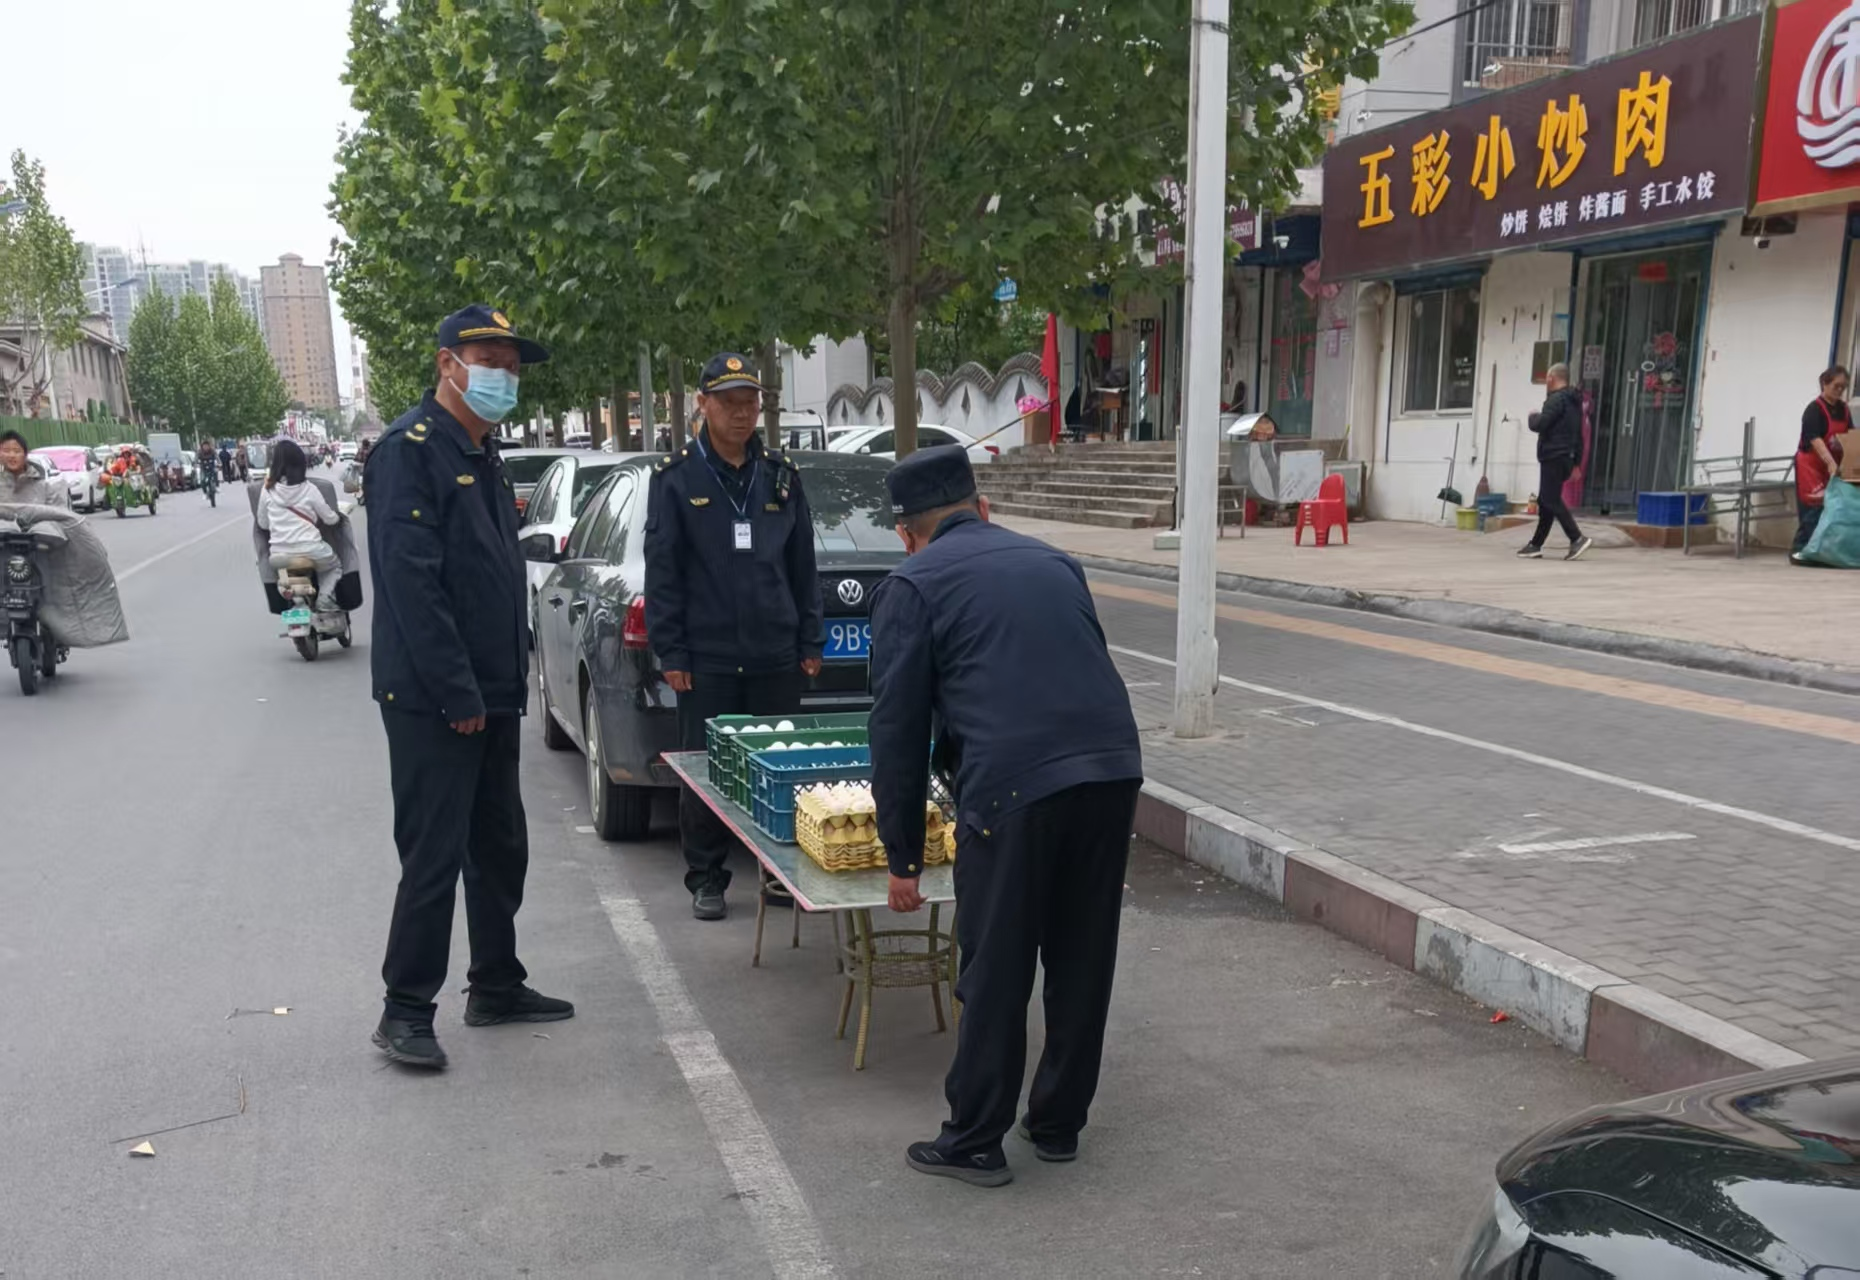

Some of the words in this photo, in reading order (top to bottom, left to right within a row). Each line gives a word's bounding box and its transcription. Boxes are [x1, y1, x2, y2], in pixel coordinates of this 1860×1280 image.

[1358, 71, 1672, 229] 五彩小炒肉
[1500, 208, 1528, 237] 炒饼
[1578, 189, 1627, 222] 炸酱面
[1639, 170, 1716, 210] 手工水饺
